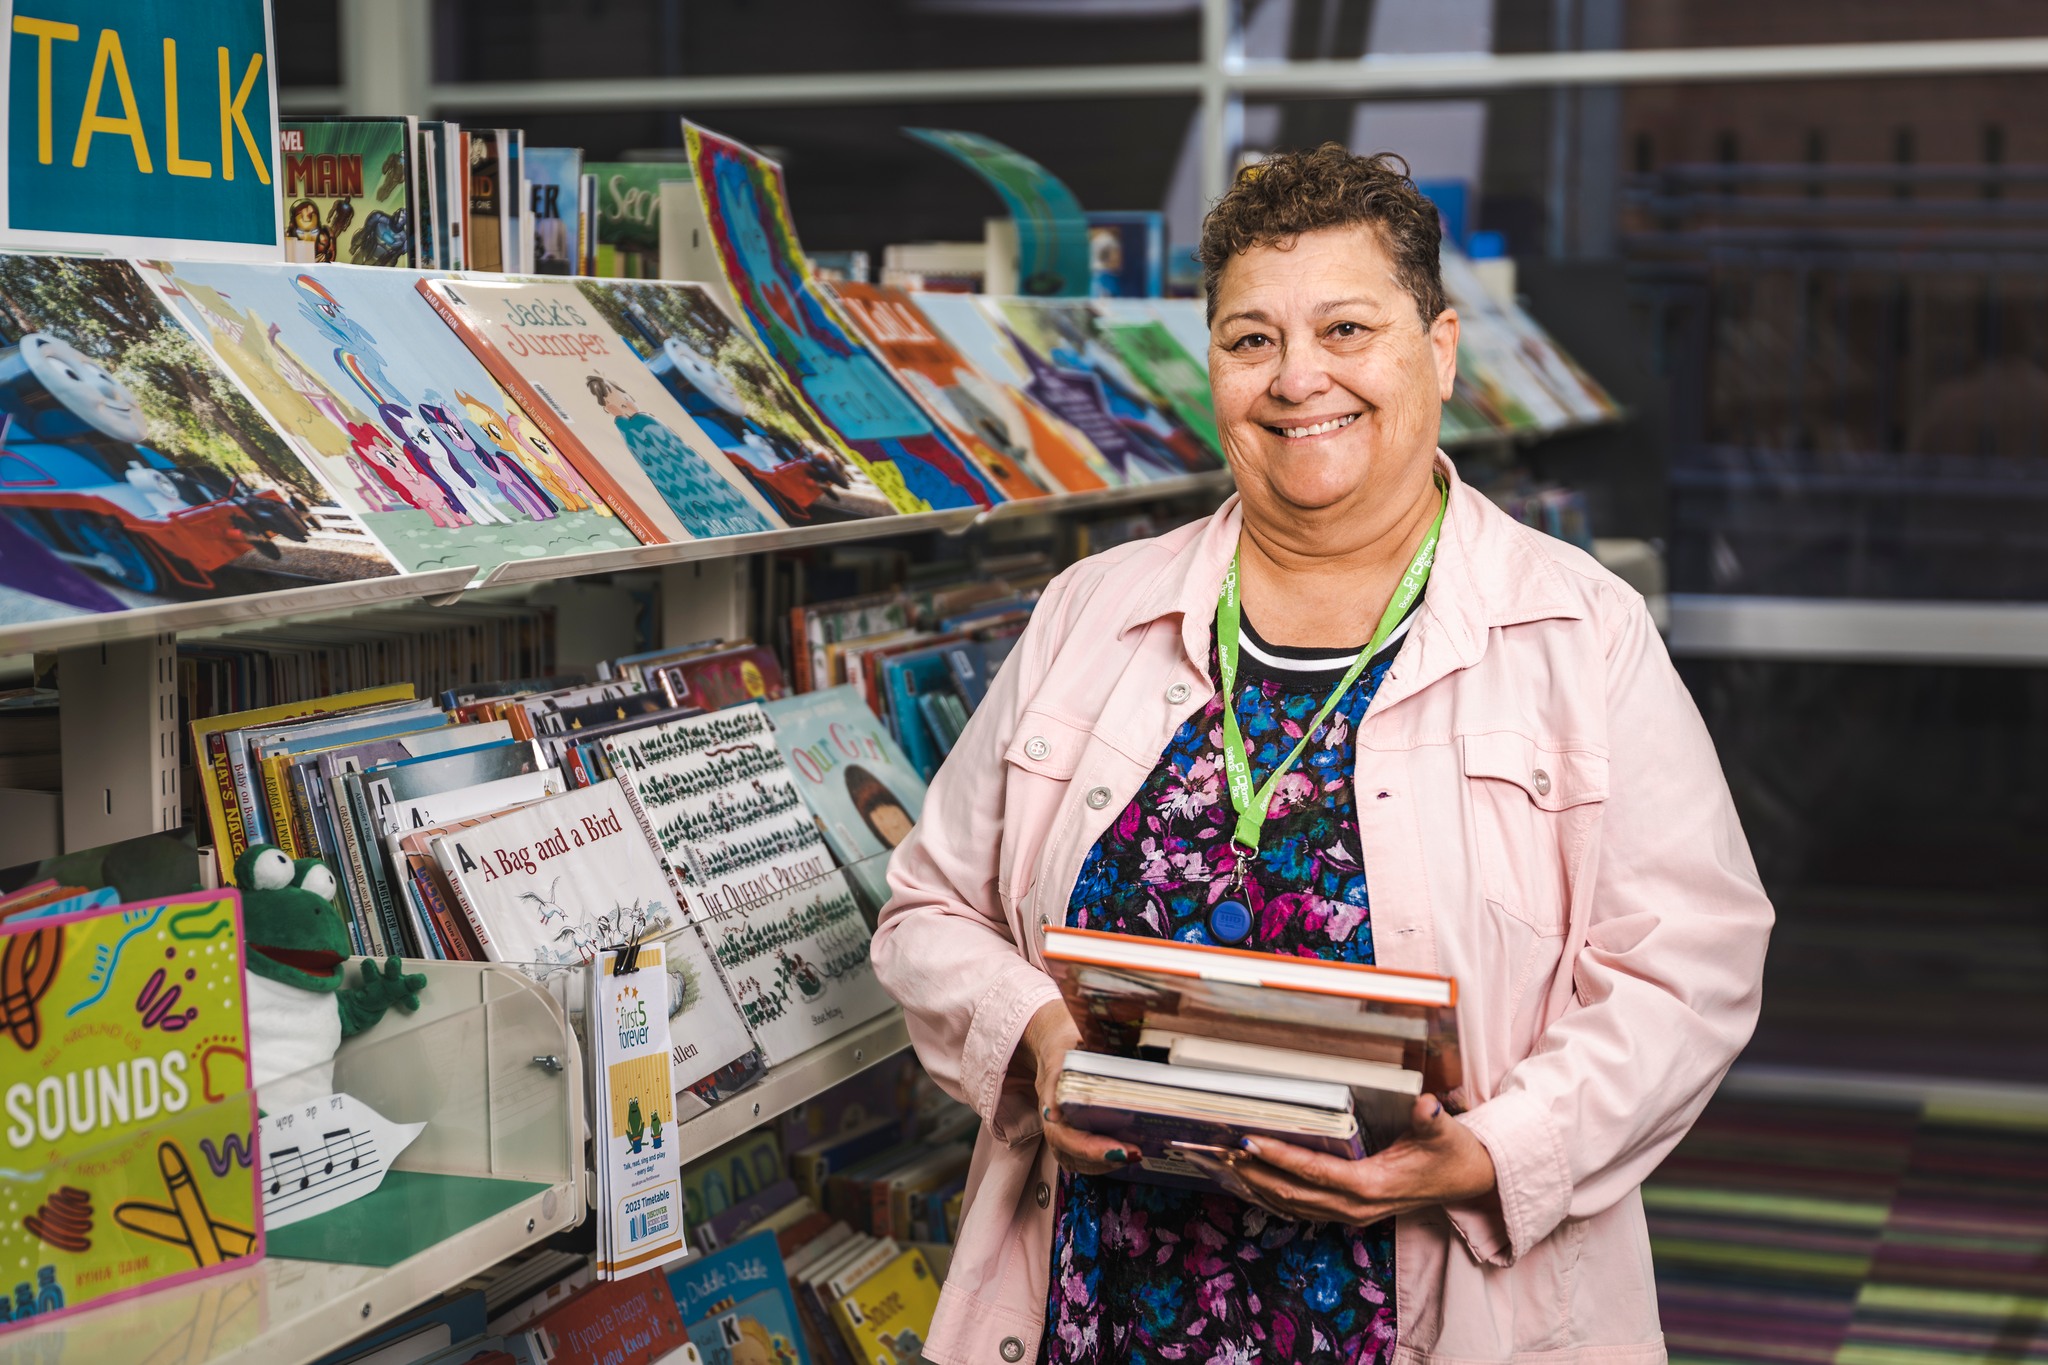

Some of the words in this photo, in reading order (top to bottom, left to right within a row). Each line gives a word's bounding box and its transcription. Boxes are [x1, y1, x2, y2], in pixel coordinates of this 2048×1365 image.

[13, 15, 271, 185] TALK
[286, 154, 364, 198] MAN
[423, 289, 441, 308] SARA
[438, 307, 459, 330] ACTON
[442, 284, 467, 306] A
[502, 298, 587, 327] Jack's
[501, 323, 610, 362] Jumper
[504, 381, 529, 407] Jack's
[526, 405, 555, 435] Jumper
[606, 493, 628, 518] WALKER
[625, 515, 647, 540] BOOKS
[1416, 537, 1436, 565] Borrow
[1226, 582, 1235, 608] Borrow
[1399, 583, 1419, 609] Bolinda
[628, 745, 646, 772] A
[791, 737, 841, 785] Our
[828, 721, 893, 765] Girl
[234, 763, 247, 788] Baby
[214, 752, 235, 801] NAT'S
[225, 806, 245, 860] NAUG
[242, 790, 250, 805] on
[619, 773, 629, 787] THE
[624, 785, 646, 825] QUEEN'S
[639, 817, 662, 852] PRESENT
[243, 803, 258, 837] Board
[265, 776, 282, 810] ARDAGH
[275, 818, 294, 854] ELWICK
[303, 811, 315, 835] DOWN
[340, 805, 355, 851] GRANDMA,
[355, 792, 367, 823] Alexander
[364, 826, 373, 843] Fogg
[351, 849, 359, 867] THE
[455, 843, 478, 874] A
[480, 855, 499, 883] A
[493, 846, 538, 876] Bag
[534, 827, 571, 862] and
[570, 828, 586, 848] a
[580, 807, 623, 843] Bird
[354, 864, 366, 886] BABY
[416, 866, 446, 914] EGG
[697, 890, 733, 924] THE
[721, 873, 777, 918] QUEEN'S
[771, 855, 834, 902] PRESENT
[359, 885, 369, 901] AND
[363, 900, 373, 915] ME
[445, 869, 454, 878] A
[450, 877, 464, 897] Bag
[460, 898, 475, 916] and
[474, 924, 490, 946] Bird
[444, 920, 456, 940] Clare
[452, 937, 465, 958] Atkins
[619, 1025, 649, 1050] forever
[673, 1042, 699, 1067] Allen
[5, 1049, 190, 1149] SOUNDS
[305, 1105, 318, 1120] de
[623, 1162, 632, 1171] Talk,
[640, 1156, 649, 1166] sing
[648, 1154, 657, 1163] and
[656, 1151, 666, 1161] play
[636, 1167, 647, 1177] every
[625, 1200, 641, 1215] 2023
[641, 1189, 670, 1209] Timetable
[646, 1205, 668, 1220] DISCOVER
[647, 1220, 669, 1236] LIBRARIES
[569, 1332, 582, 1355] If
[580, 1312, 614, 1345] you're
[612, 1291, 650, 1327] happy
[620, 1325, 651, 1354] know
[651, 1315, 663, 1338] it
[721, 1316, 741, 1346] K
